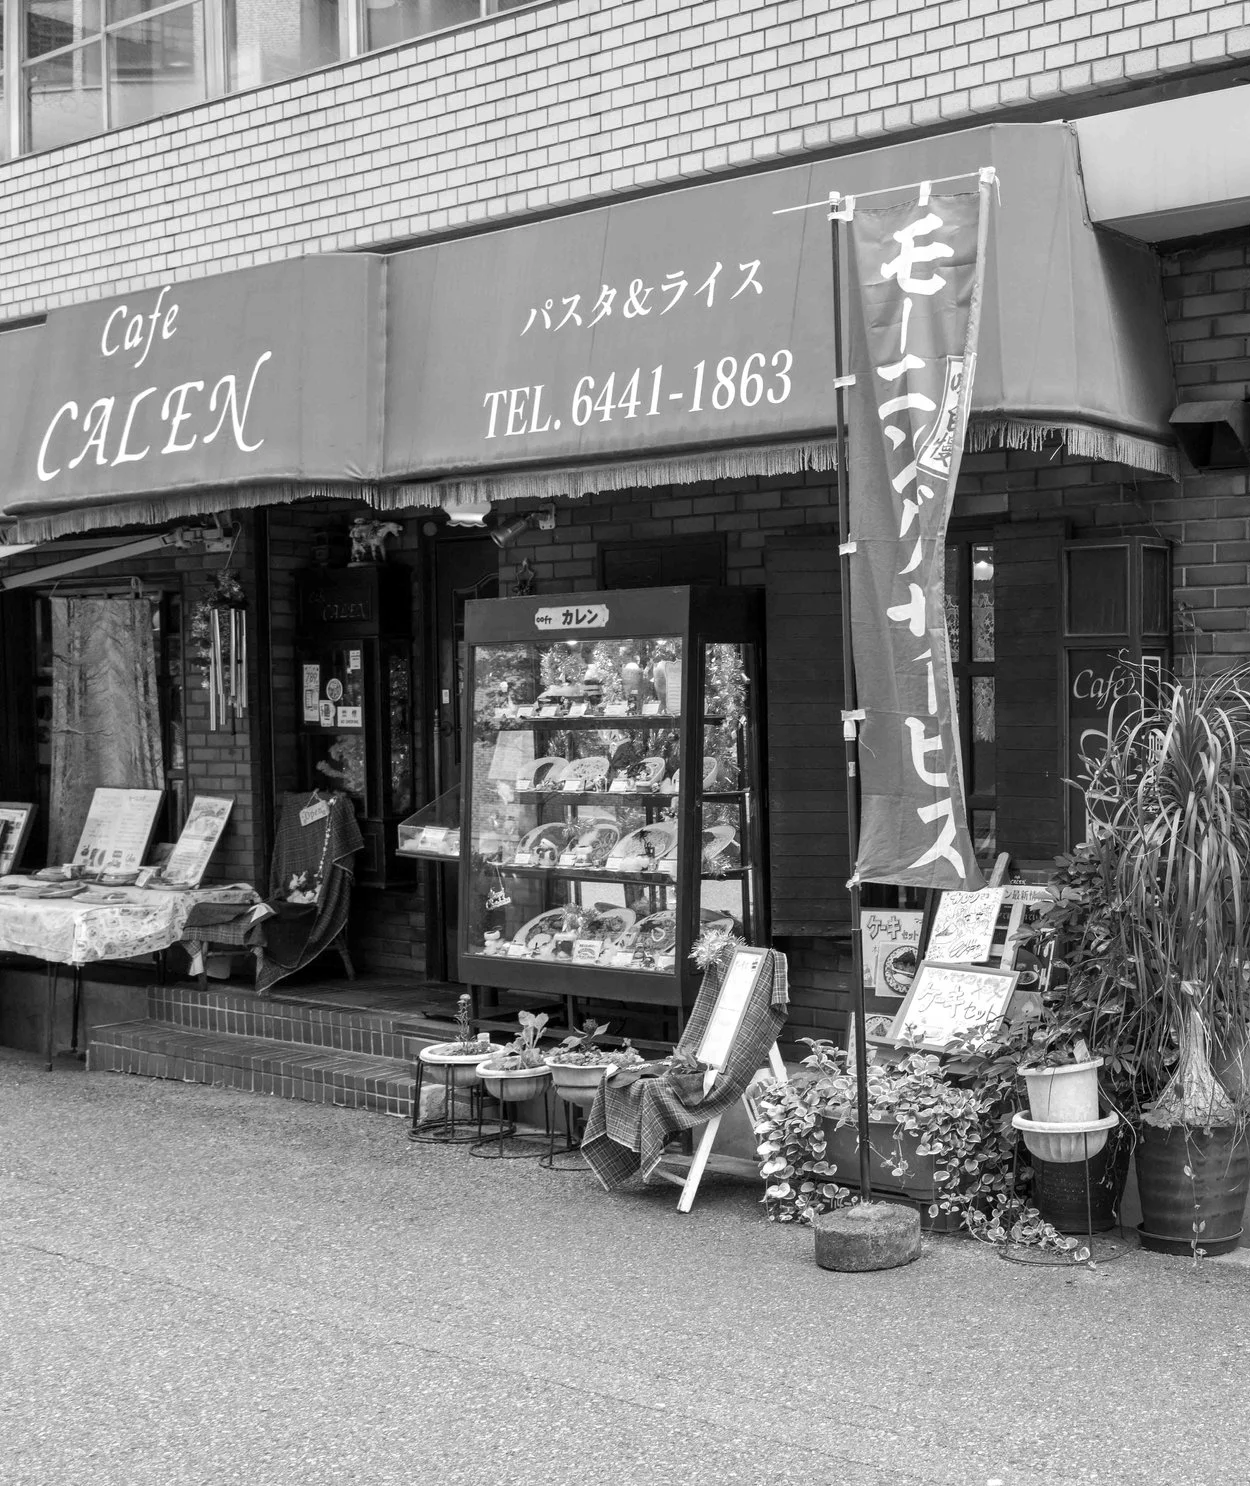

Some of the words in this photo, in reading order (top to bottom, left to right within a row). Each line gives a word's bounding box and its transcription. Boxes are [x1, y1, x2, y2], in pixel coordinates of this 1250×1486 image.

[101, 285, 179, 368] Cafe
[520, 259, 763, 337] パスタ&ライス
[37, 350, 272, 481] CALEN
[483, 384, 561, 439] TEL.
[571, 349, 793, 427] 6441-1863
[562, 608, 598, 625] カレン
[918, 982, 997, 1022] ケーキセット
